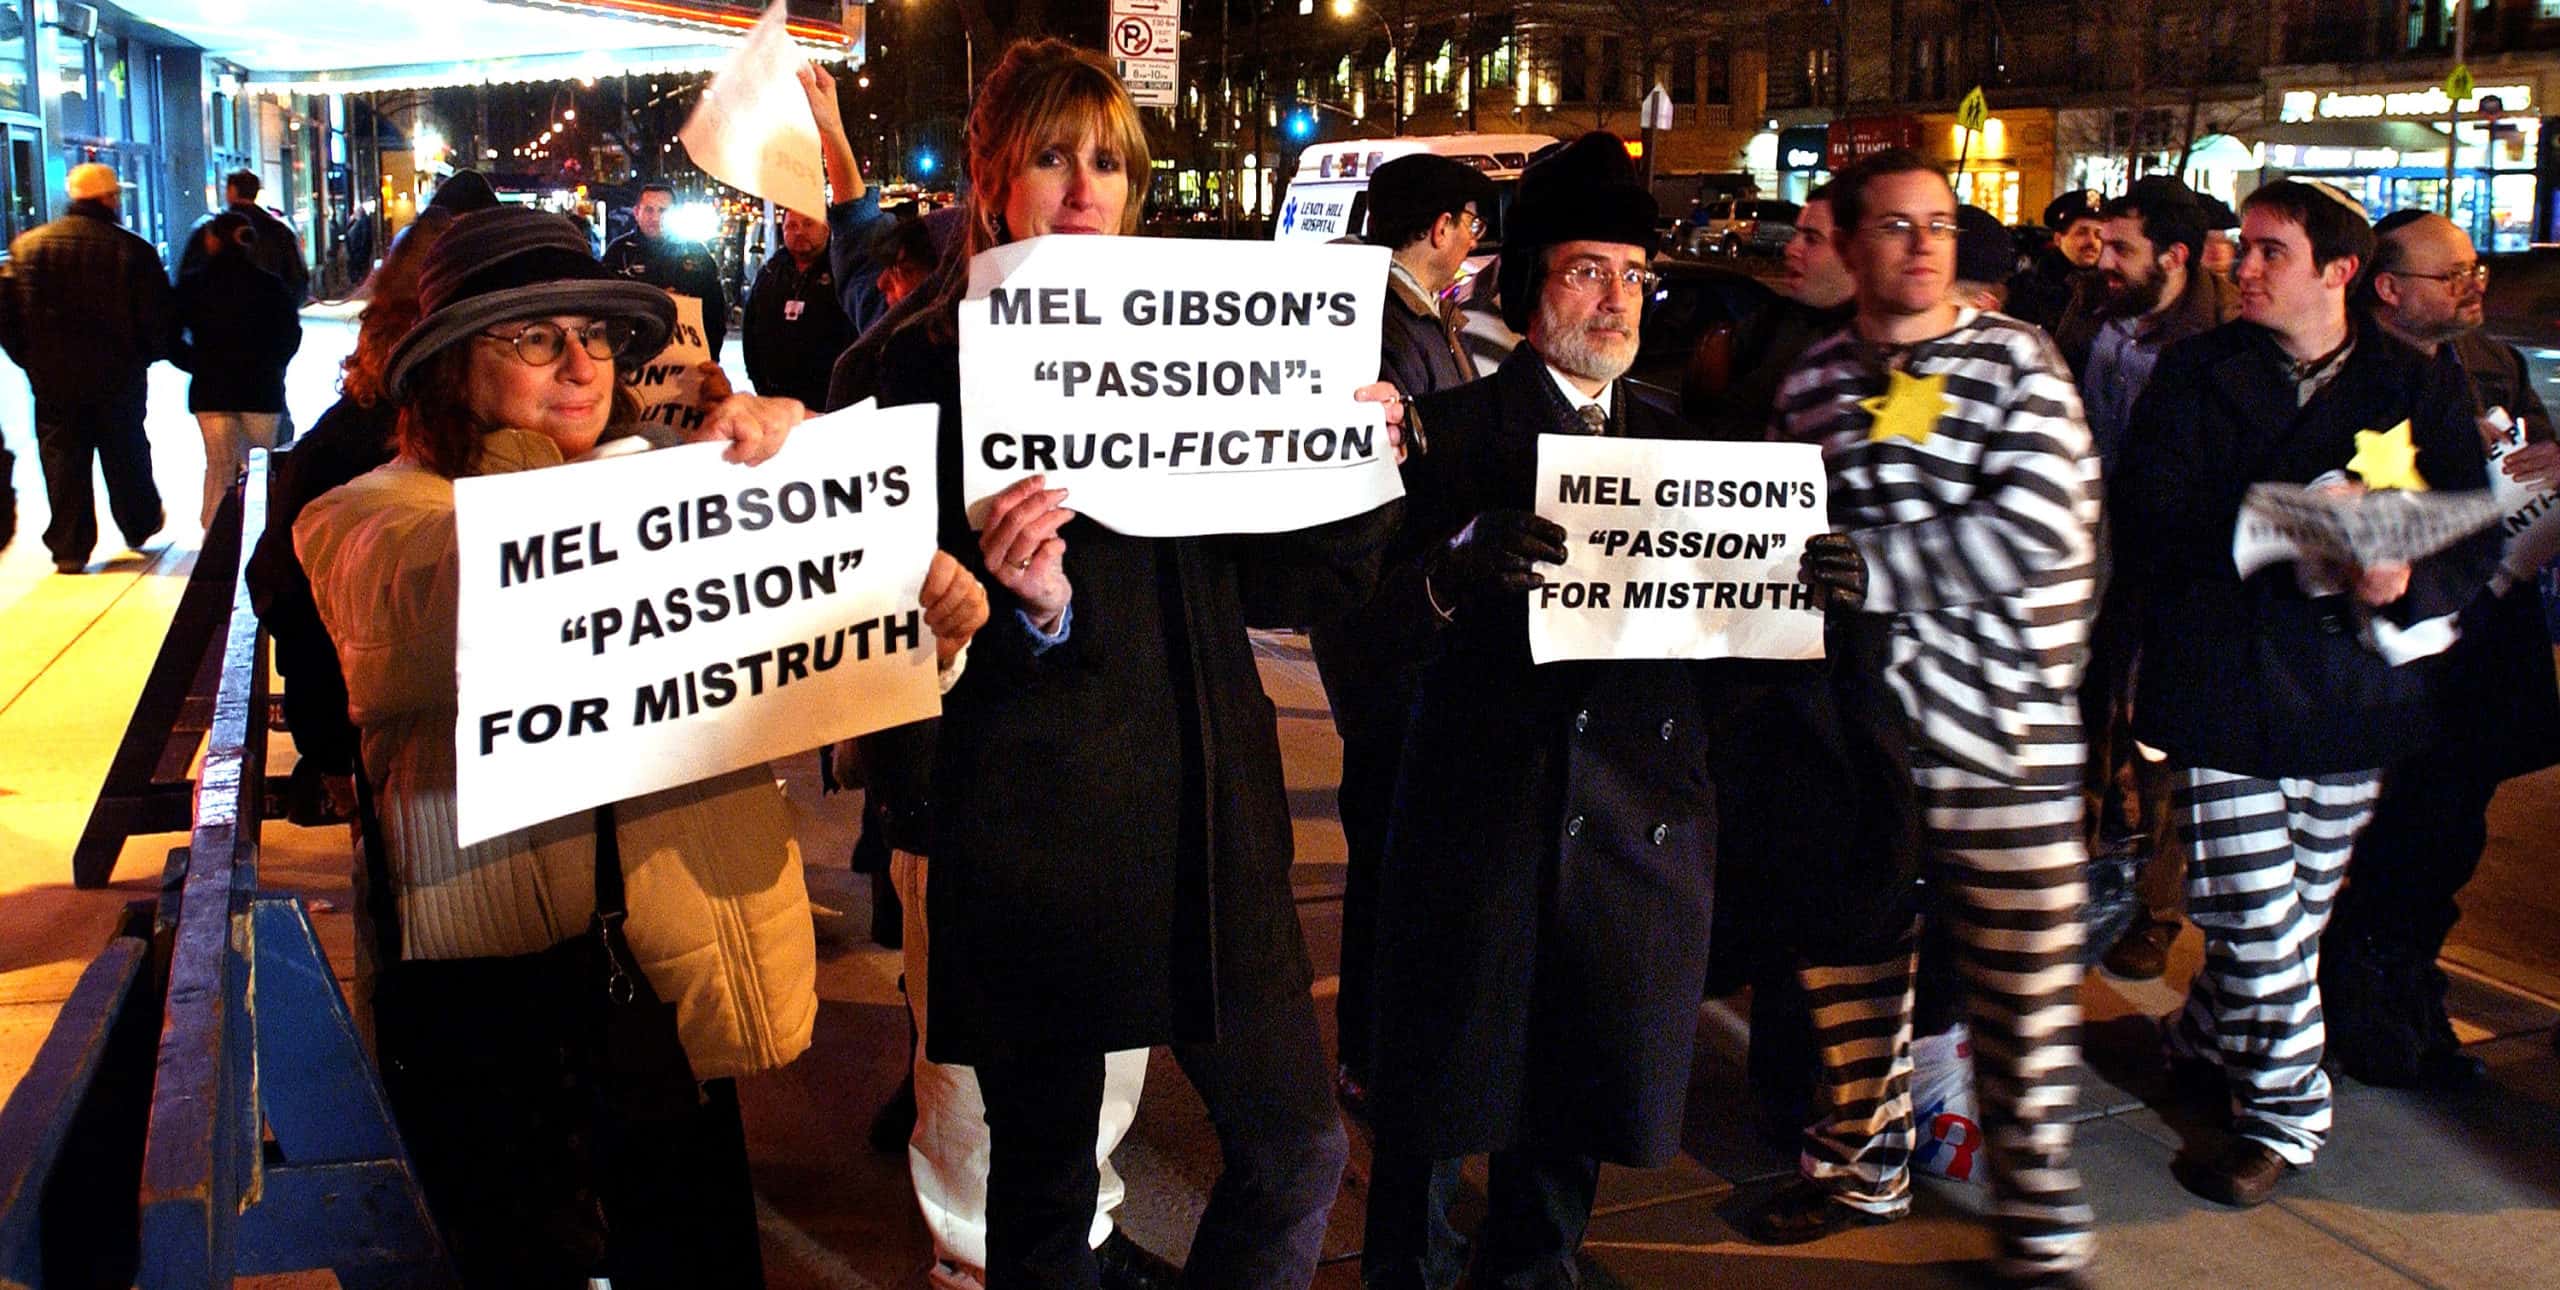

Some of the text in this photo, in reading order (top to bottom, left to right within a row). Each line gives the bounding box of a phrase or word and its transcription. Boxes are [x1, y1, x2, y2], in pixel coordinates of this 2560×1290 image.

[1300, 218, 1335, 233] HOSPITAL
[1326, 203, 1343, 216] HILL
[989, 288, 1356, 327] MEL GIBSON’S
[1035, 361, 1322, 397] “PASSION”:
[981, 425, 1374, 471] CRUCI-FICTION
[1560, 475, 1815, 508] MEL GIBSON’S
[501, 466, 910, 588] MEL GIBSON’S
[1589, 530, 1786, 559] “PASSION”
[561, 549, 864, 655] “PASSION”
[1541, 582, 1815, 610] FOR MISTRUTH
[480, 610, 919, 755] FOR MISTRUTH
